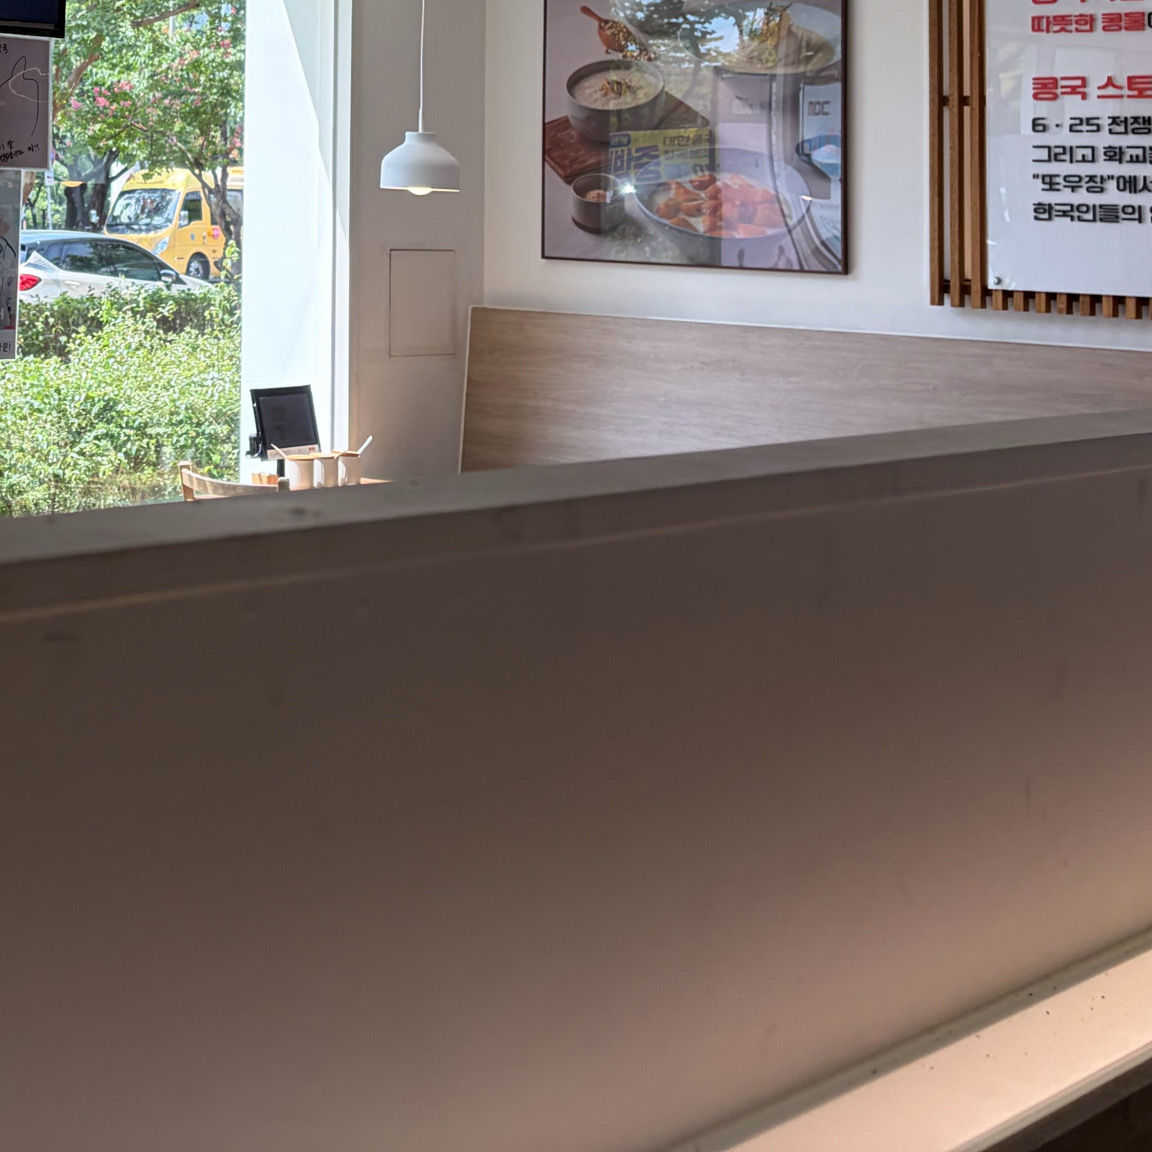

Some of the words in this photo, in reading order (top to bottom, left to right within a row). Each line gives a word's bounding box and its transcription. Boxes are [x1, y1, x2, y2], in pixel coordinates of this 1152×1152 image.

[1031, 13, 1095, 34] 따뜻한
[1101, 11, 1152, 32] 콩물
[1032, 76, 1087, 101] 콩국
[1032, 145, 1096, 164] 그리고
[1103, 145, 1152, 164] 화교
[1032, 201, 1143, 224] 한국인들의
